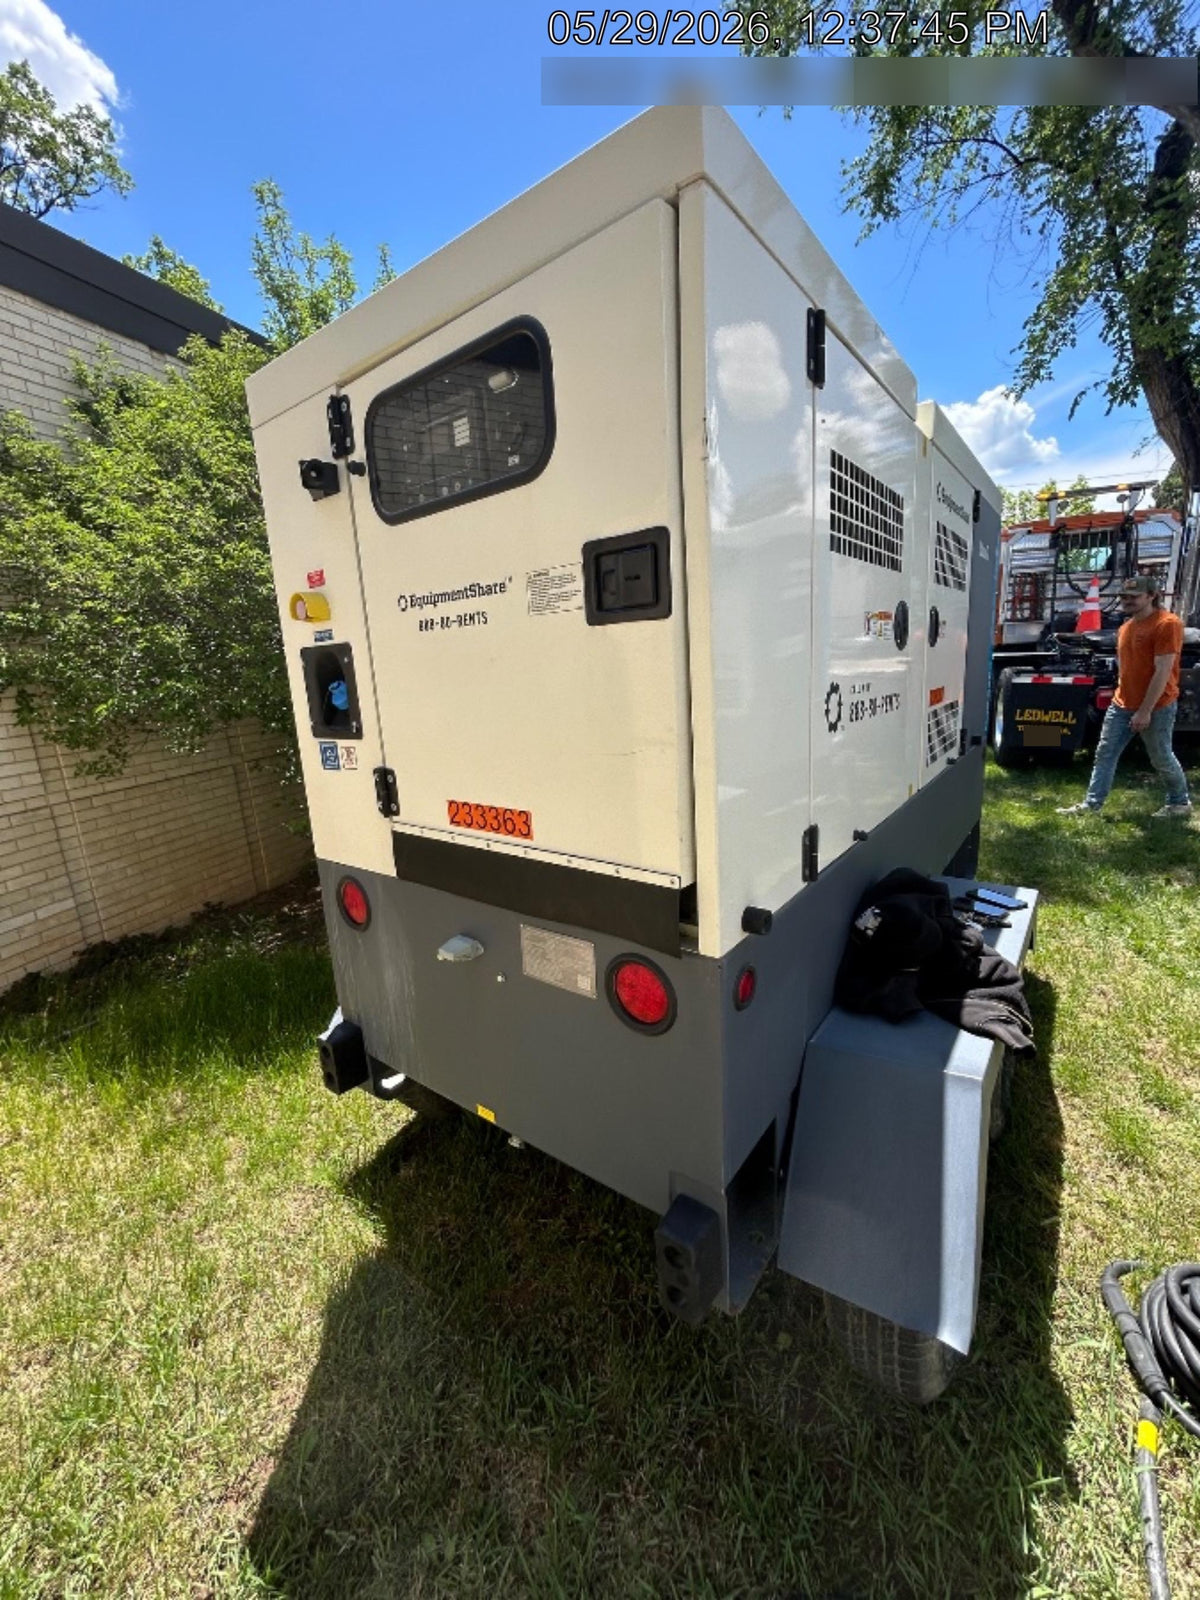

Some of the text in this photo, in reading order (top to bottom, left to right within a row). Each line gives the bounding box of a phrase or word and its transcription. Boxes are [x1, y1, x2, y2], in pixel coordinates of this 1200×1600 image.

[409, 581, 506, 610] EquipmentShare
[1015, 708, 1077, 724] LEDWELL
[448, 801, 531, 837] 233363
